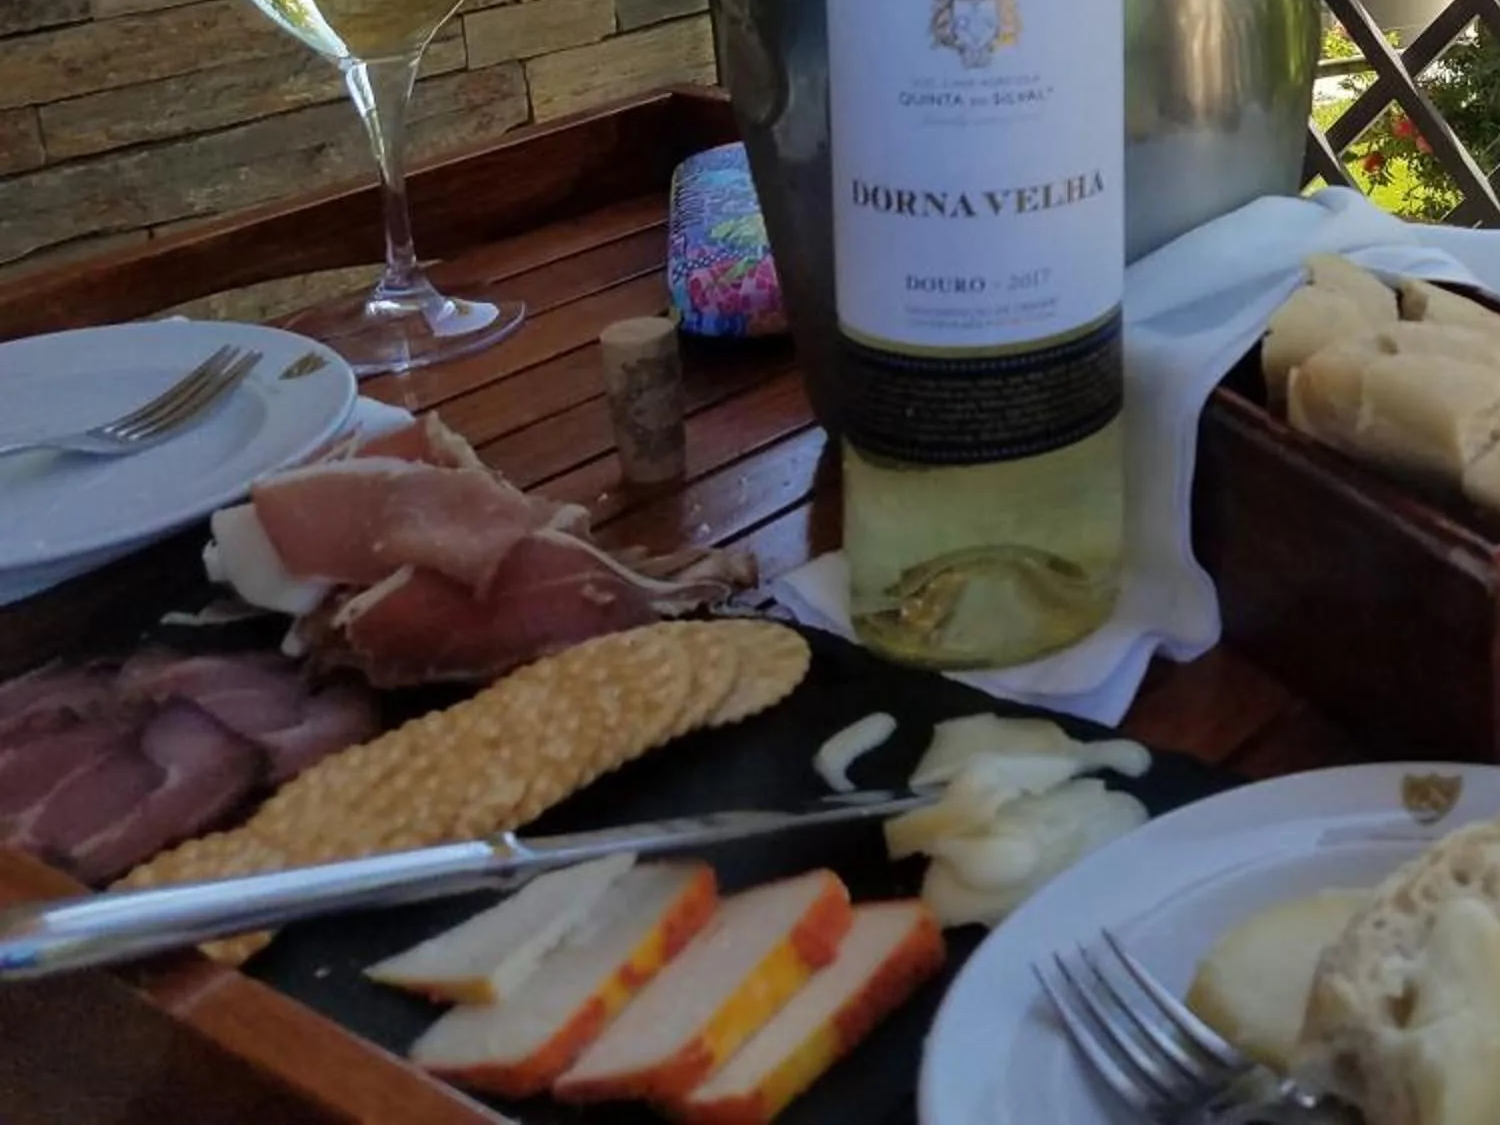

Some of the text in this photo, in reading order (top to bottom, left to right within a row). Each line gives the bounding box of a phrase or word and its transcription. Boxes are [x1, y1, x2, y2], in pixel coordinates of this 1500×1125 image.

[852, 169, 1105, 217] DORNA VELHA
[905, 274, 987, 293] DOURO
